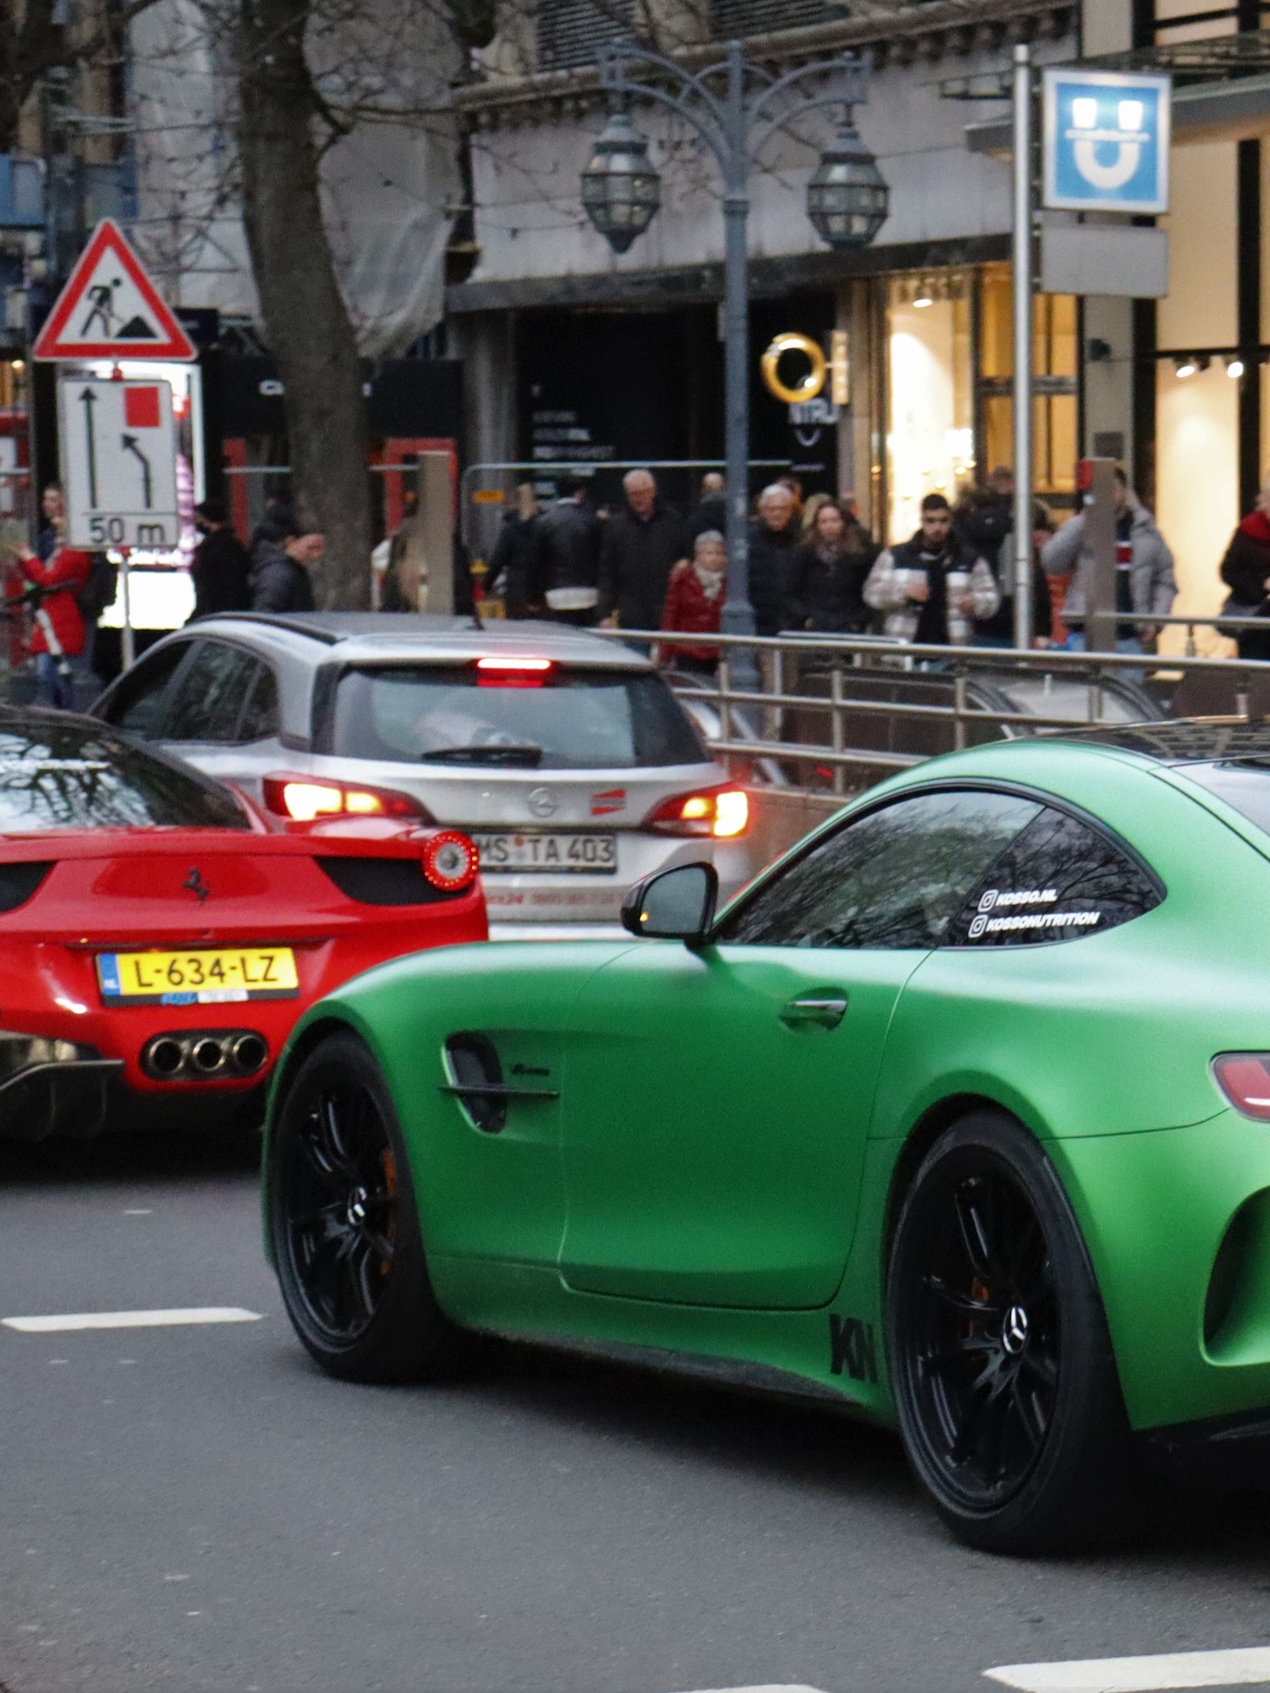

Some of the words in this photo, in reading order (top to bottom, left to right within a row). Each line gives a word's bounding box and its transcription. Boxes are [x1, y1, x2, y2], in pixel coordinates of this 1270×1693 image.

[89, 517, 124, 543] 50
[137, 524, 165, 544] m
[528, 836, 560, 862] TA
[567, 837, 613, 862] 403
[996, 889, 1058, 906] KOSSO.NL
[986, 911, 1100, 931] KOSSONUTRITION
[133, 955, 278, 987] L-634-LZ
